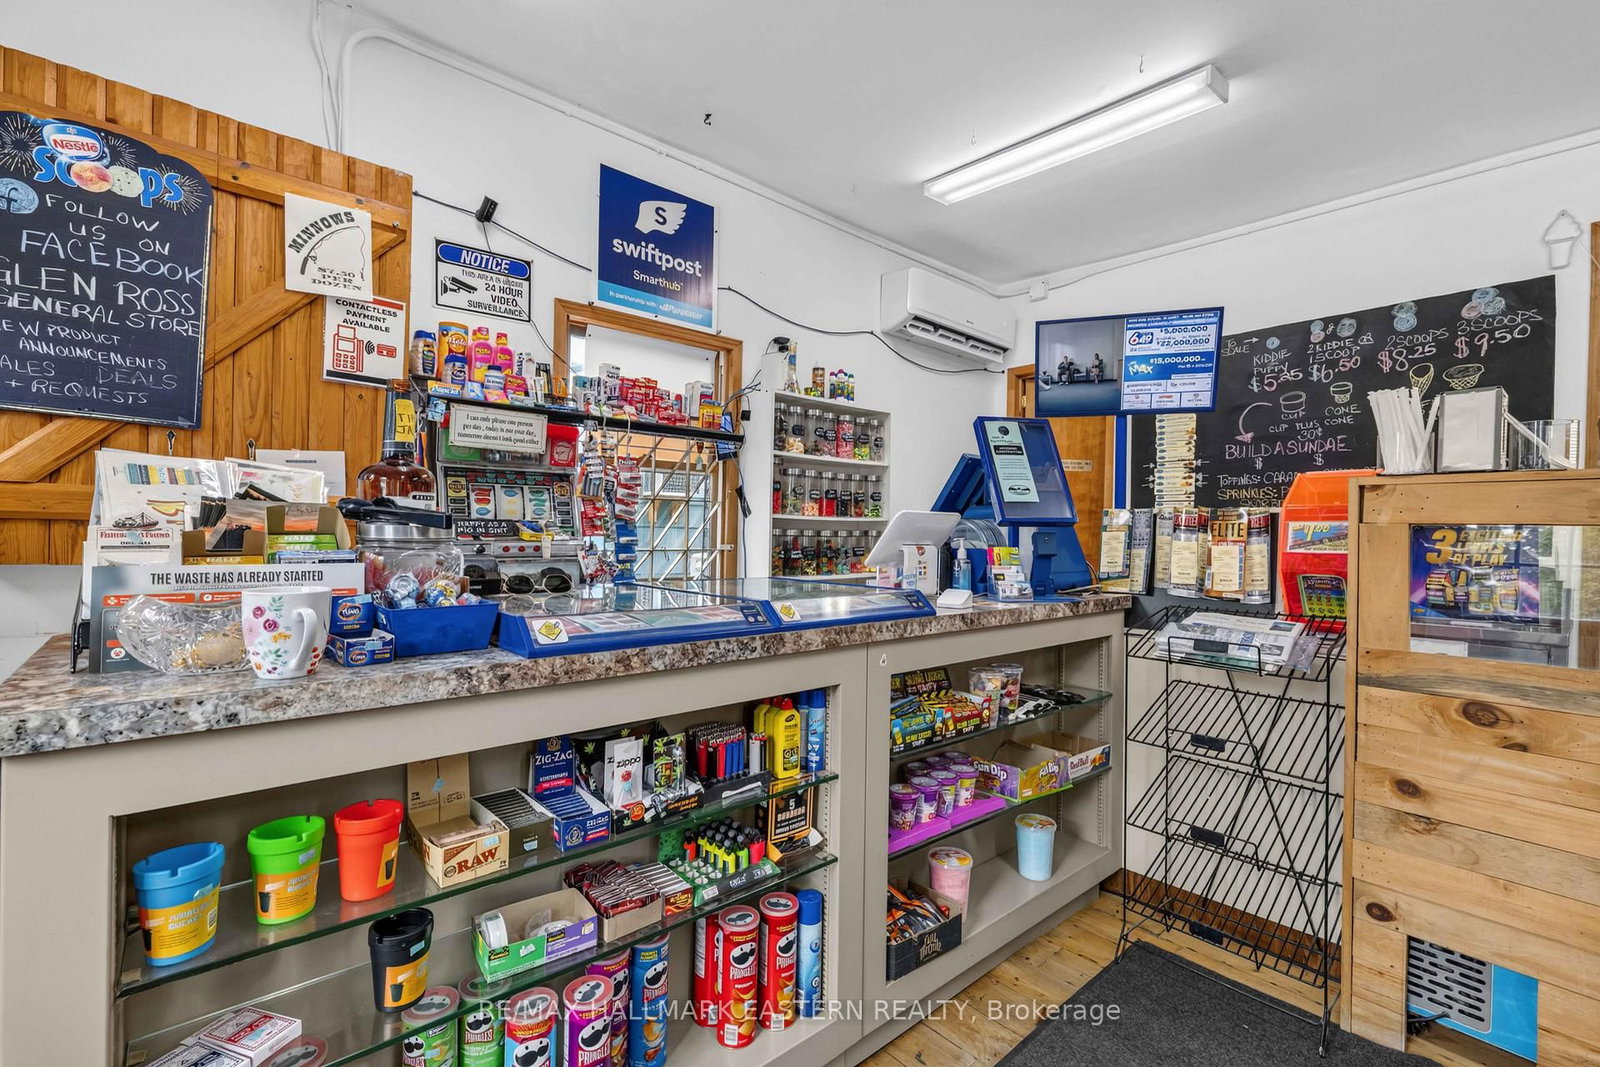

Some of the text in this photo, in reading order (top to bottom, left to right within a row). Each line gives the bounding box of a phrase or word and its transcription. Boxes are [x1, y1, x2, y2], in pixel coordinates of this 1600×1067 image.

[46, 194, 160, 231] FOLLOW
[70, 222, 170, 255] US ON
[288, 211, 356, 254] MINNOWS
[20, 229, 205, 288] FACEBOOK
[460, 249, 511, 274] NOTICE
[612, 238, 703, 278] swiftpost
[311, 278, 362, 291] DOZEN
[484, 282, 524, 299] 24 HOUR
[113, 281, 195, 315] ROSS
[335, 298, 398, 318] CONTACTLESS
[467, 299, 524, 318] SURVEILLANCE
[490, 294, 518, 308] VIDEO
[0, 287, 200, 337] GENERAL STORE
[346, 309, 387, 324] PAYMENT
[0, 319, 121, 345] EW PRODUCT
[342, 317, 391, 333] AVAILABLE
[19, 337, 168, 371] ANNOUNCEMENTS
[1454, 324, 1531, 359] $9.50
[1253, 349, 1292, 366] KIDDIE
[1308, 356, 1361, 384] $6.50
[1377, 343, 1437, 373] $8.25
[0, 355, 178, 389] ALES DEALS
[1248, 368, 1304, 393] $5.25
[31, 378, 149, 404] REQUESTS
[1325, 403, 1362, 416] CONE
[1269, 415, 1354, 433] CUP PLUS CONE
[1225, 435, 1352, 460] BUILD A SUNDAE
[1212, 521, 1245, 538] ELITE
[1426, 529, 1457, 564] 3
[150, 570, 324, 585] THE WASTE HAS ALREADY STARTED
[535, 750, 573, 766] ZIG-ZAG
[789, 798, 796, 810] 5
[456, 845, 500, 875] RAW
